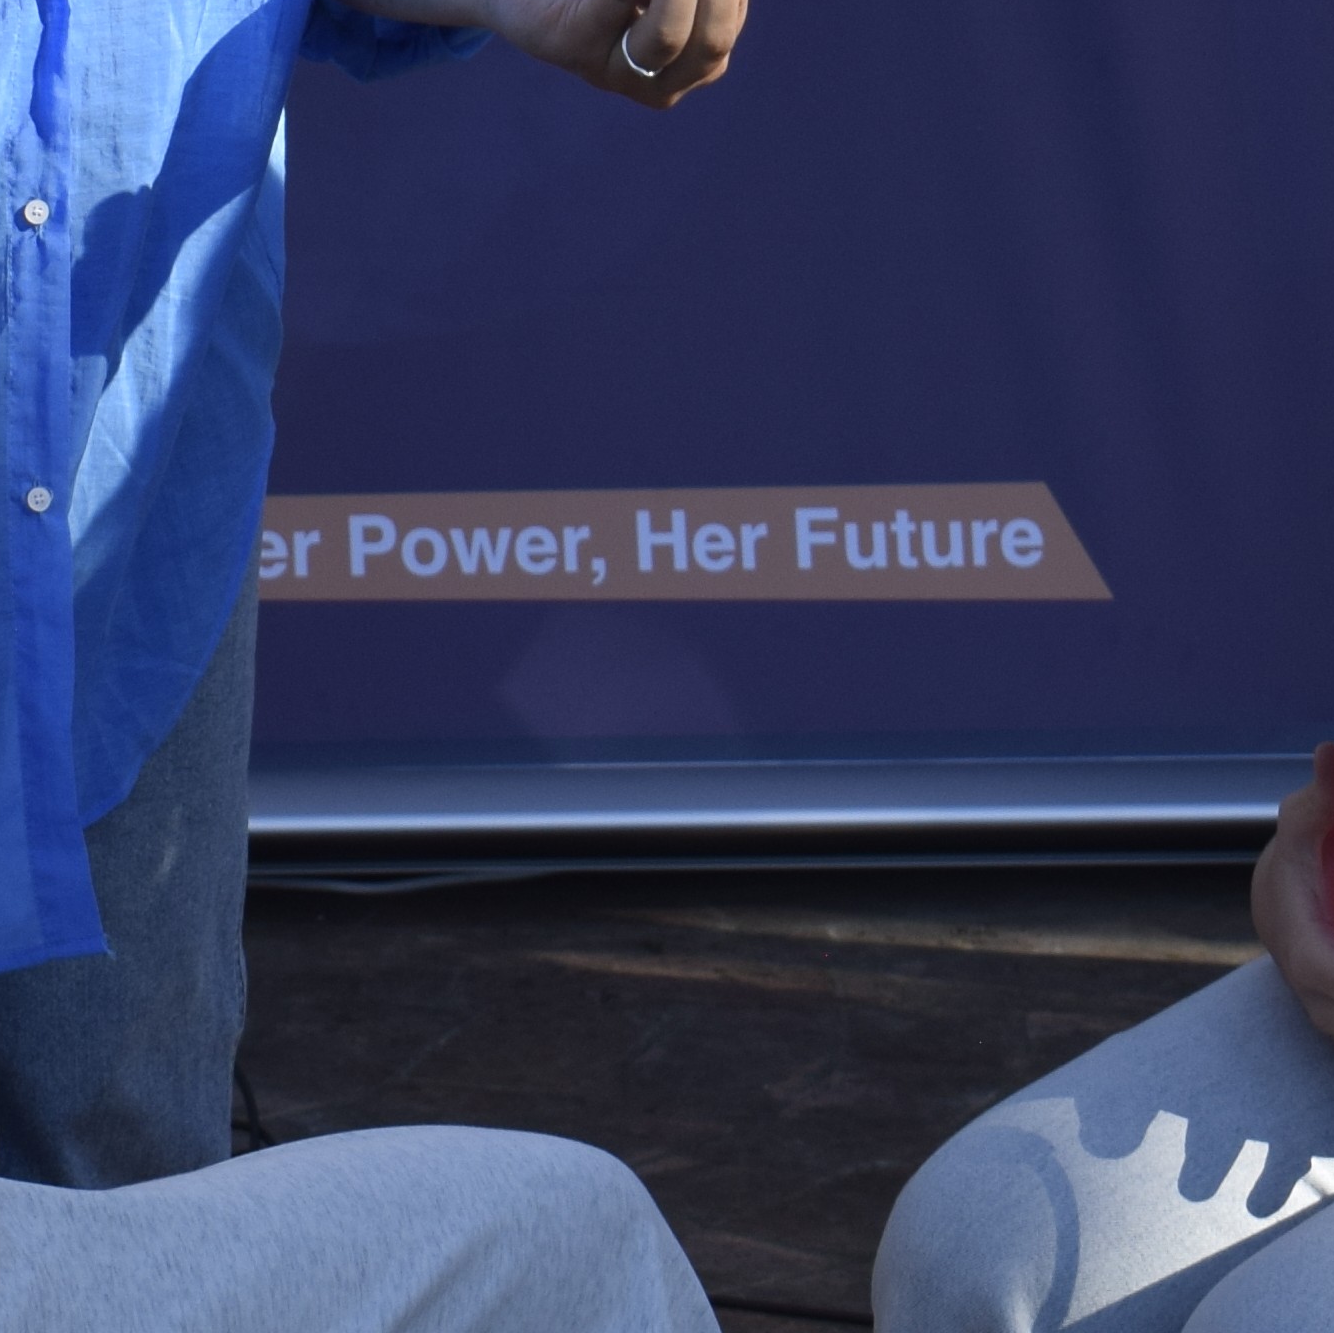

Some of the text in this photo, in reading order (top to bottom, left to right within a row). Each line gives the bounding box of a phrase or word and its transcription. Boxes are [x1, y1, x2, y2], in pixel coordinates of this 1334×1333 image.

[259, 507, 1044, 586] er Power, Her Future
